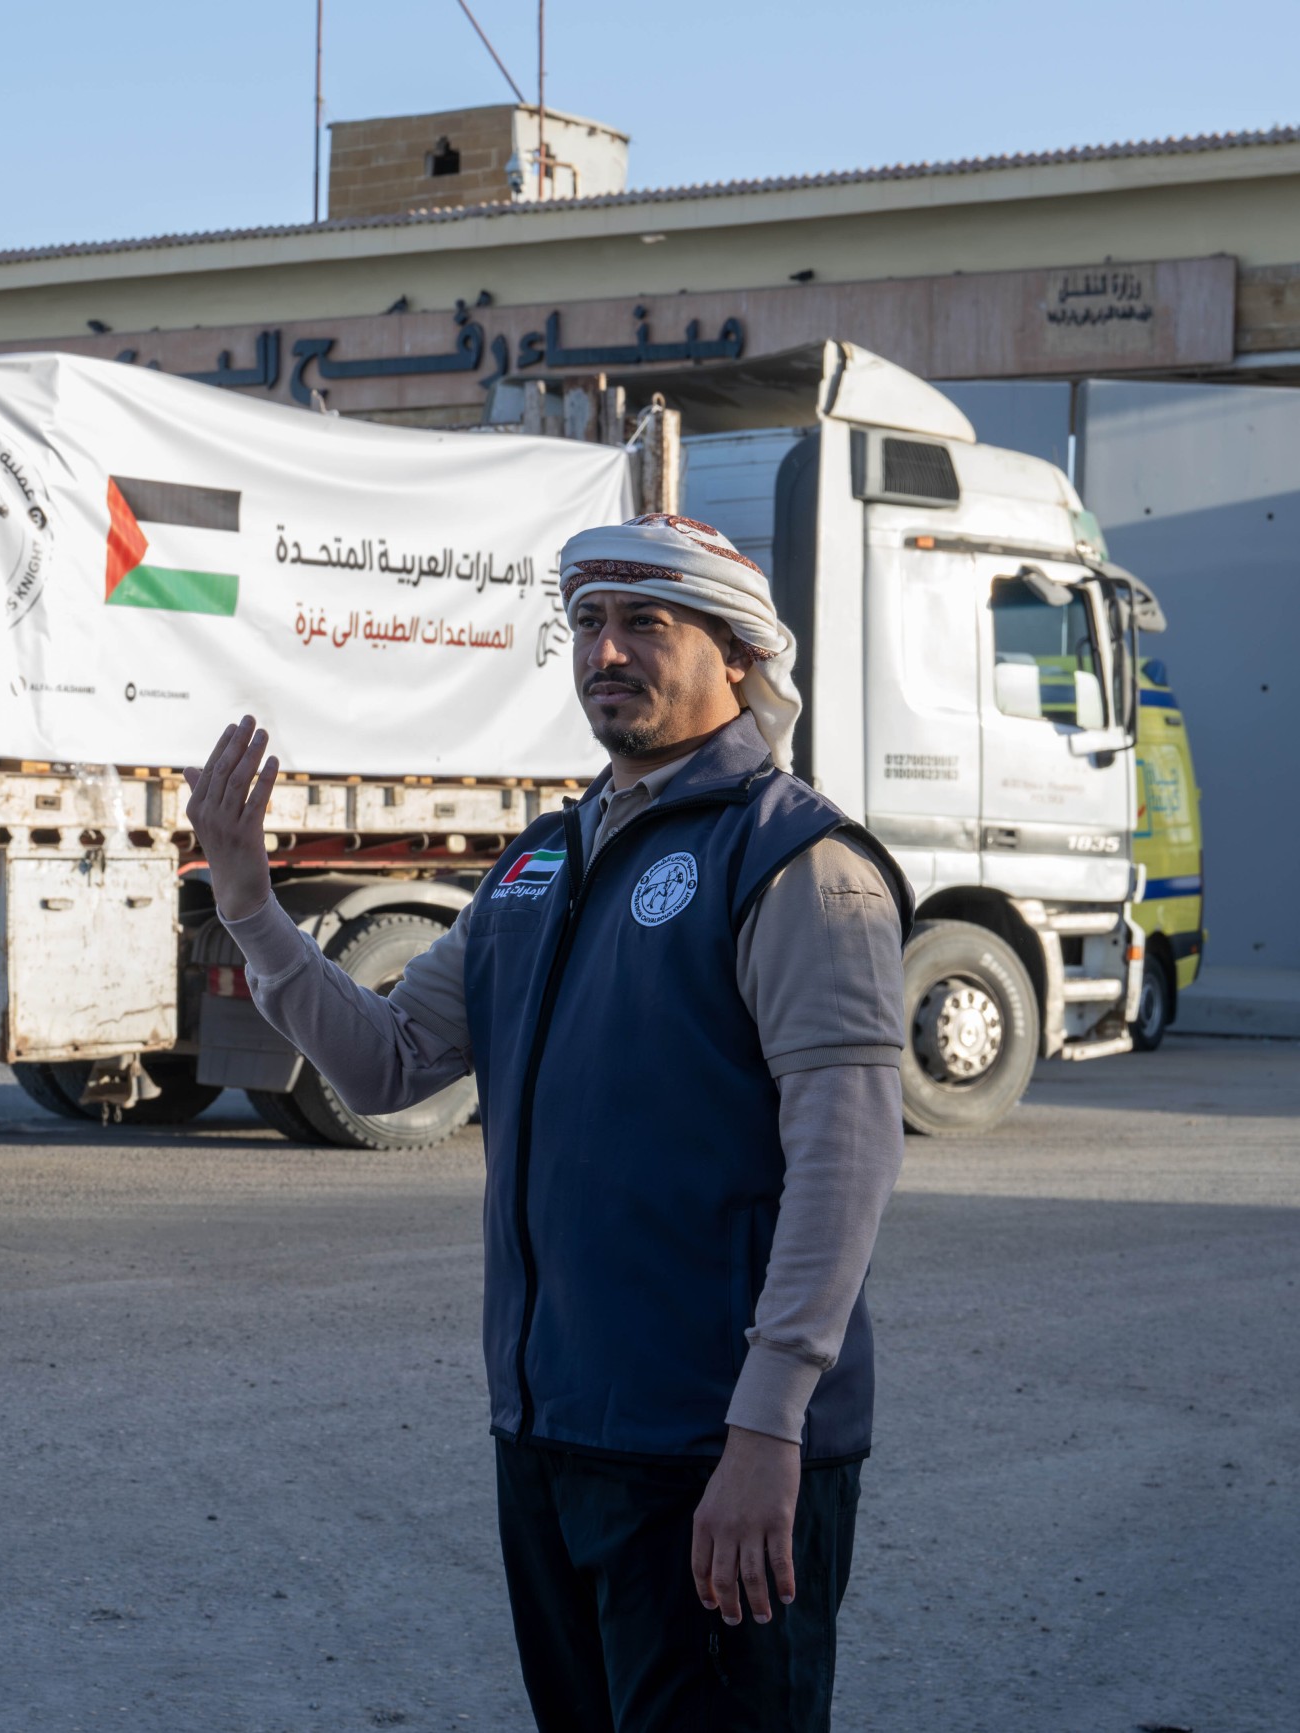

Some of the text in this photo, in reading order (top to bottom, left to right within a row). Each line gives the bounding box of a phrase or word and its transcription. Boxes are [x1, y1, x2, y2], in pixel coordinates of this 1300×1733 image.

[291, 304, 508, 406] رفح
[517, 304, 746, 367] ميناء
[0, 449, 35, 501] عملية
[15, 539, 42, 603] KNIGHT
[276, 524, 534, 599] الإمارات العربية المتحدة
[295, 602, 327, 645] غزة
[363, 610, 420, 649] الطبية
[421, 619, 514, 650] المساعدات
[1066, 834, 1120, 853] 1835
[491, 887, 511, 899] UAE
[641, 911, 673, 923] CHIVALROUS
[673, 891, 692, 913] KNIGHT
